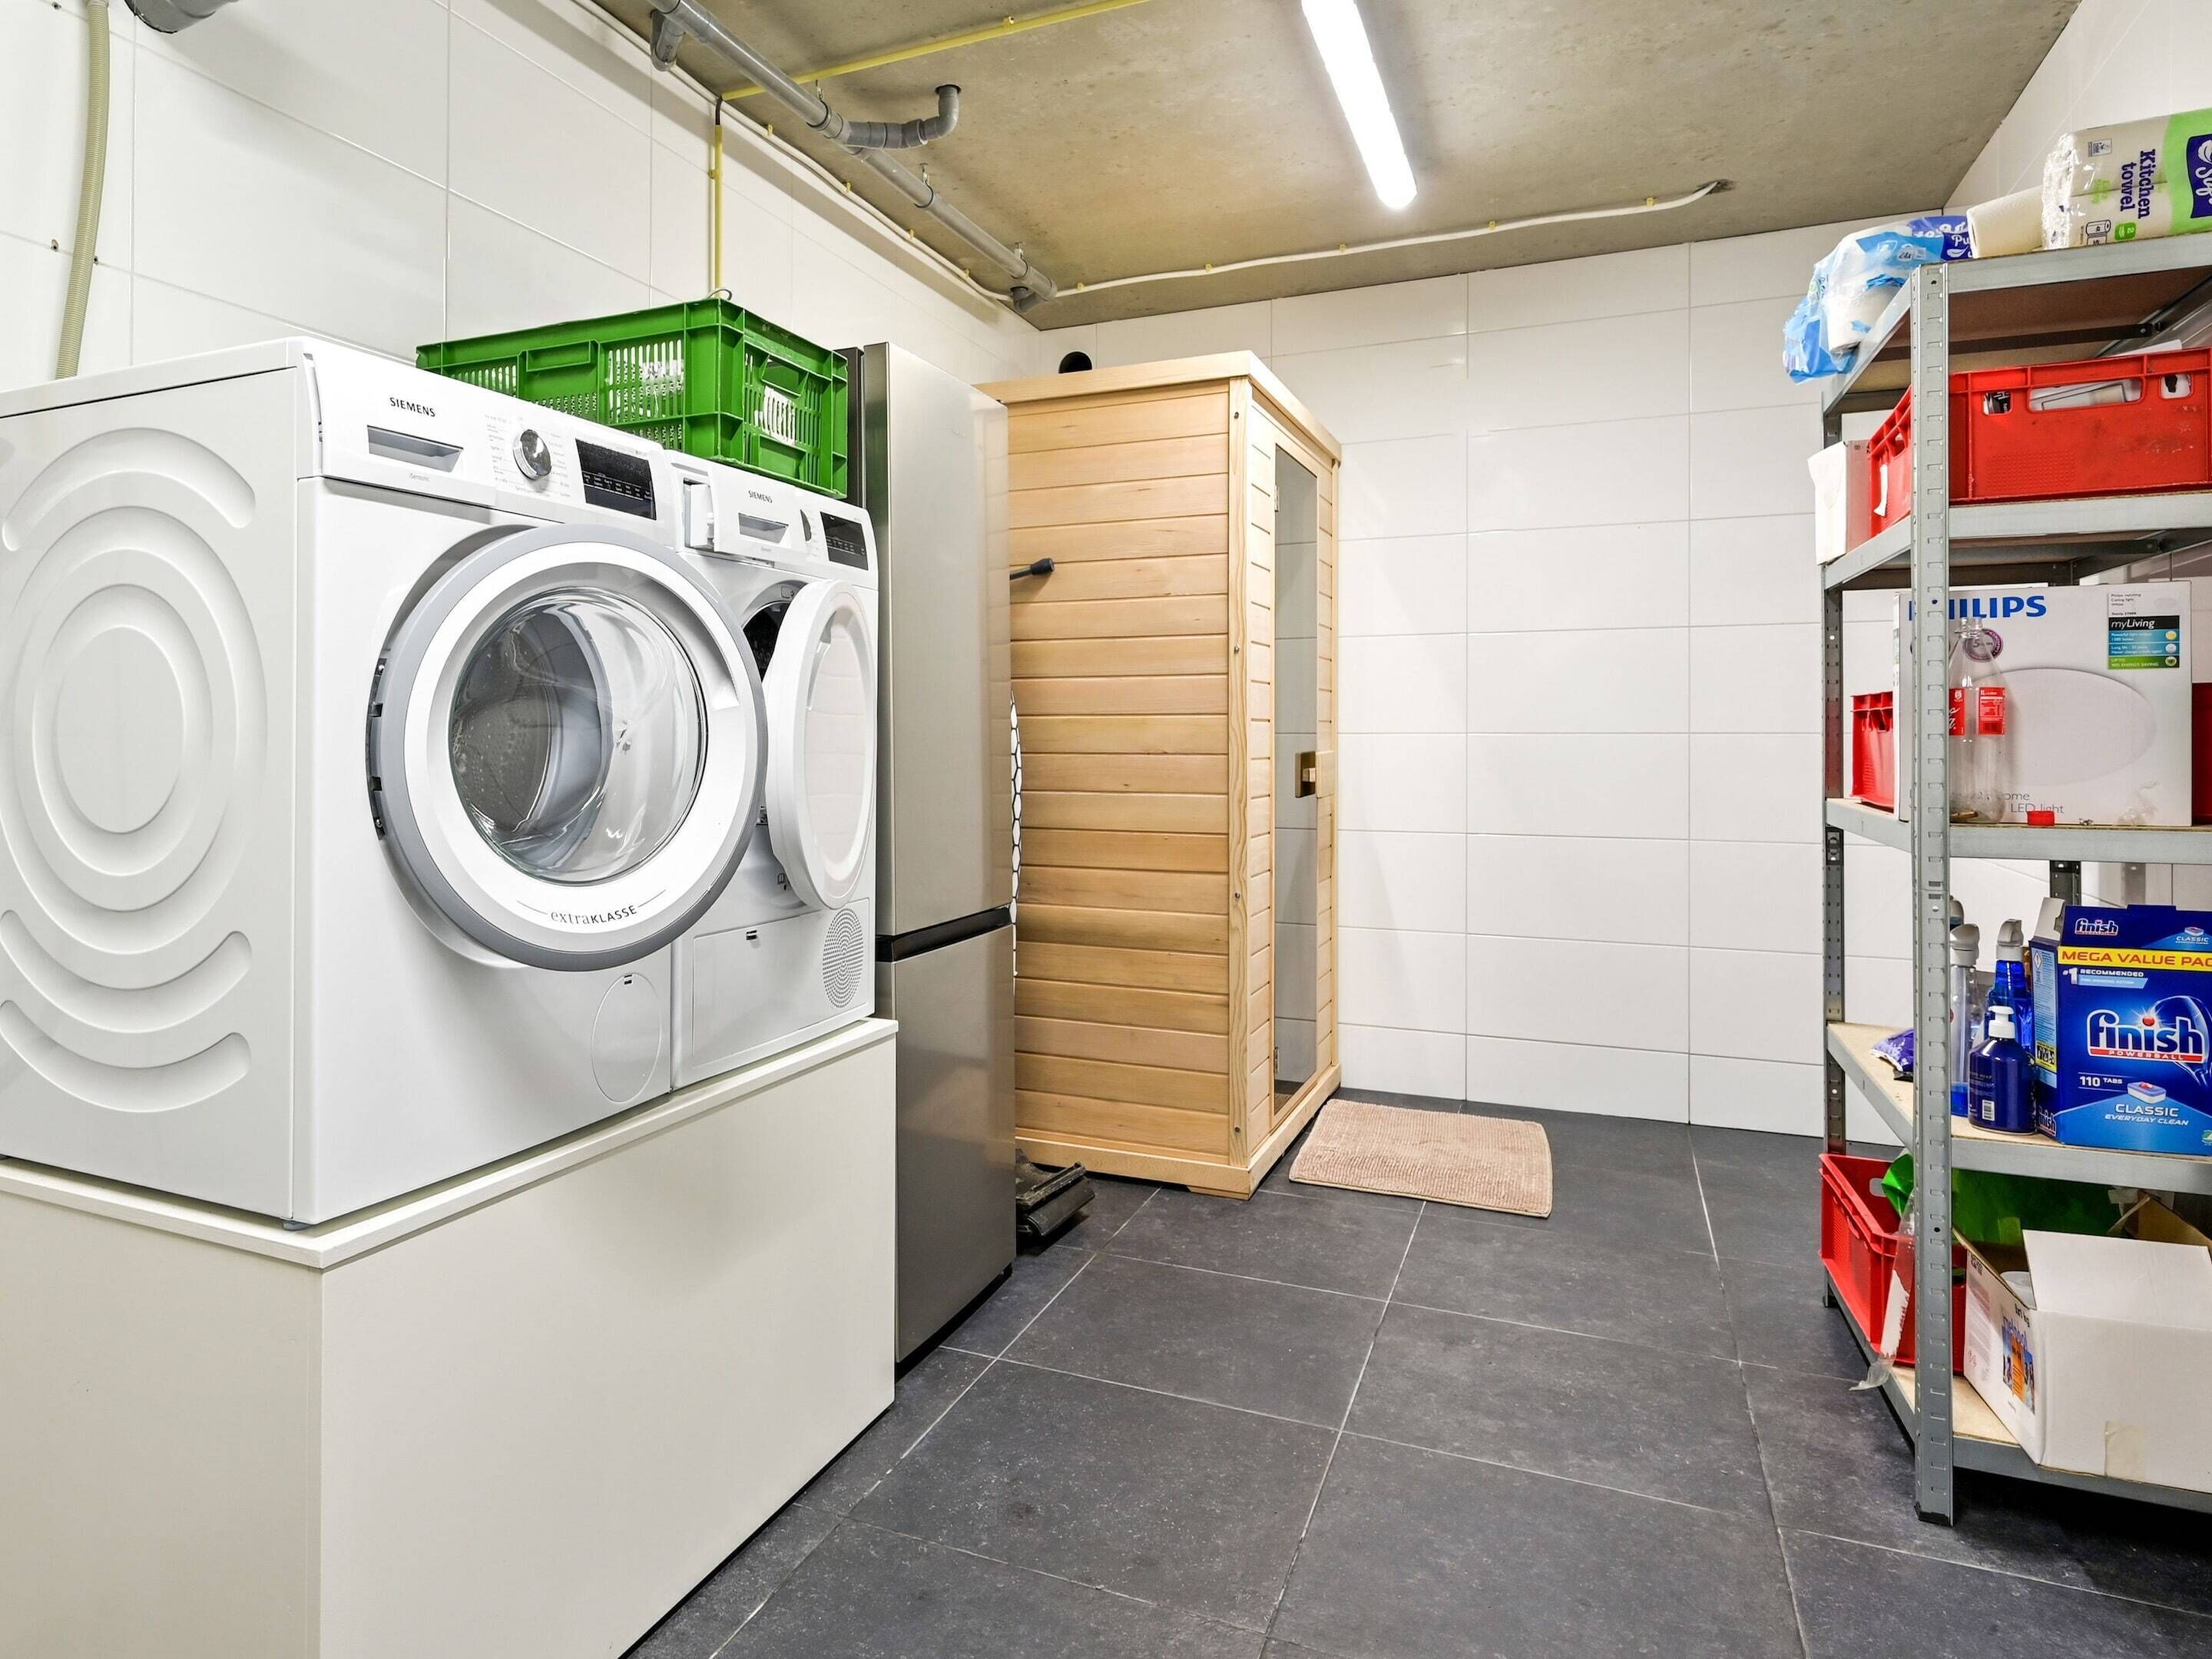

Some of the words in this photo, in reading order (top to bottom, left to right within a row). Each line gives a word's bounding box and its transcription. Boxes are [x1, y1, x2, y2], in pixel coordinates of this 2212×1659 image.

[2120, 162, 2137, 212] towel
[2137, 149, 2155, 219] Kitchen
[389, 397, 435, 417] SIEMENS
[748, 490, 773, 503] SIEMENS
[2111, 619, 2155, 630] myLiving
[2011, 803, 2035, 813] LED
[2076, 918, 2118, 933] finish
[2062, 951, 2112, 962] MEGA
[2118, 953, 2176, 965] VALUE
[2062, 968, 2078, 985] #1
[2080, 969, 2144, 977] RECOMMENDED
[2088, 1009, 2204, 1055] finish
[2108, 1050, 2184, 1061] POWERBALL
[2079, 1076, 2101, 1087] 110
[2115, 1104, 2179, 1118] CLASSIC
[2104, 1114, 2157, 1124] EVERYDAY
[2157, 1118, 2189, 1126] CLEAN
